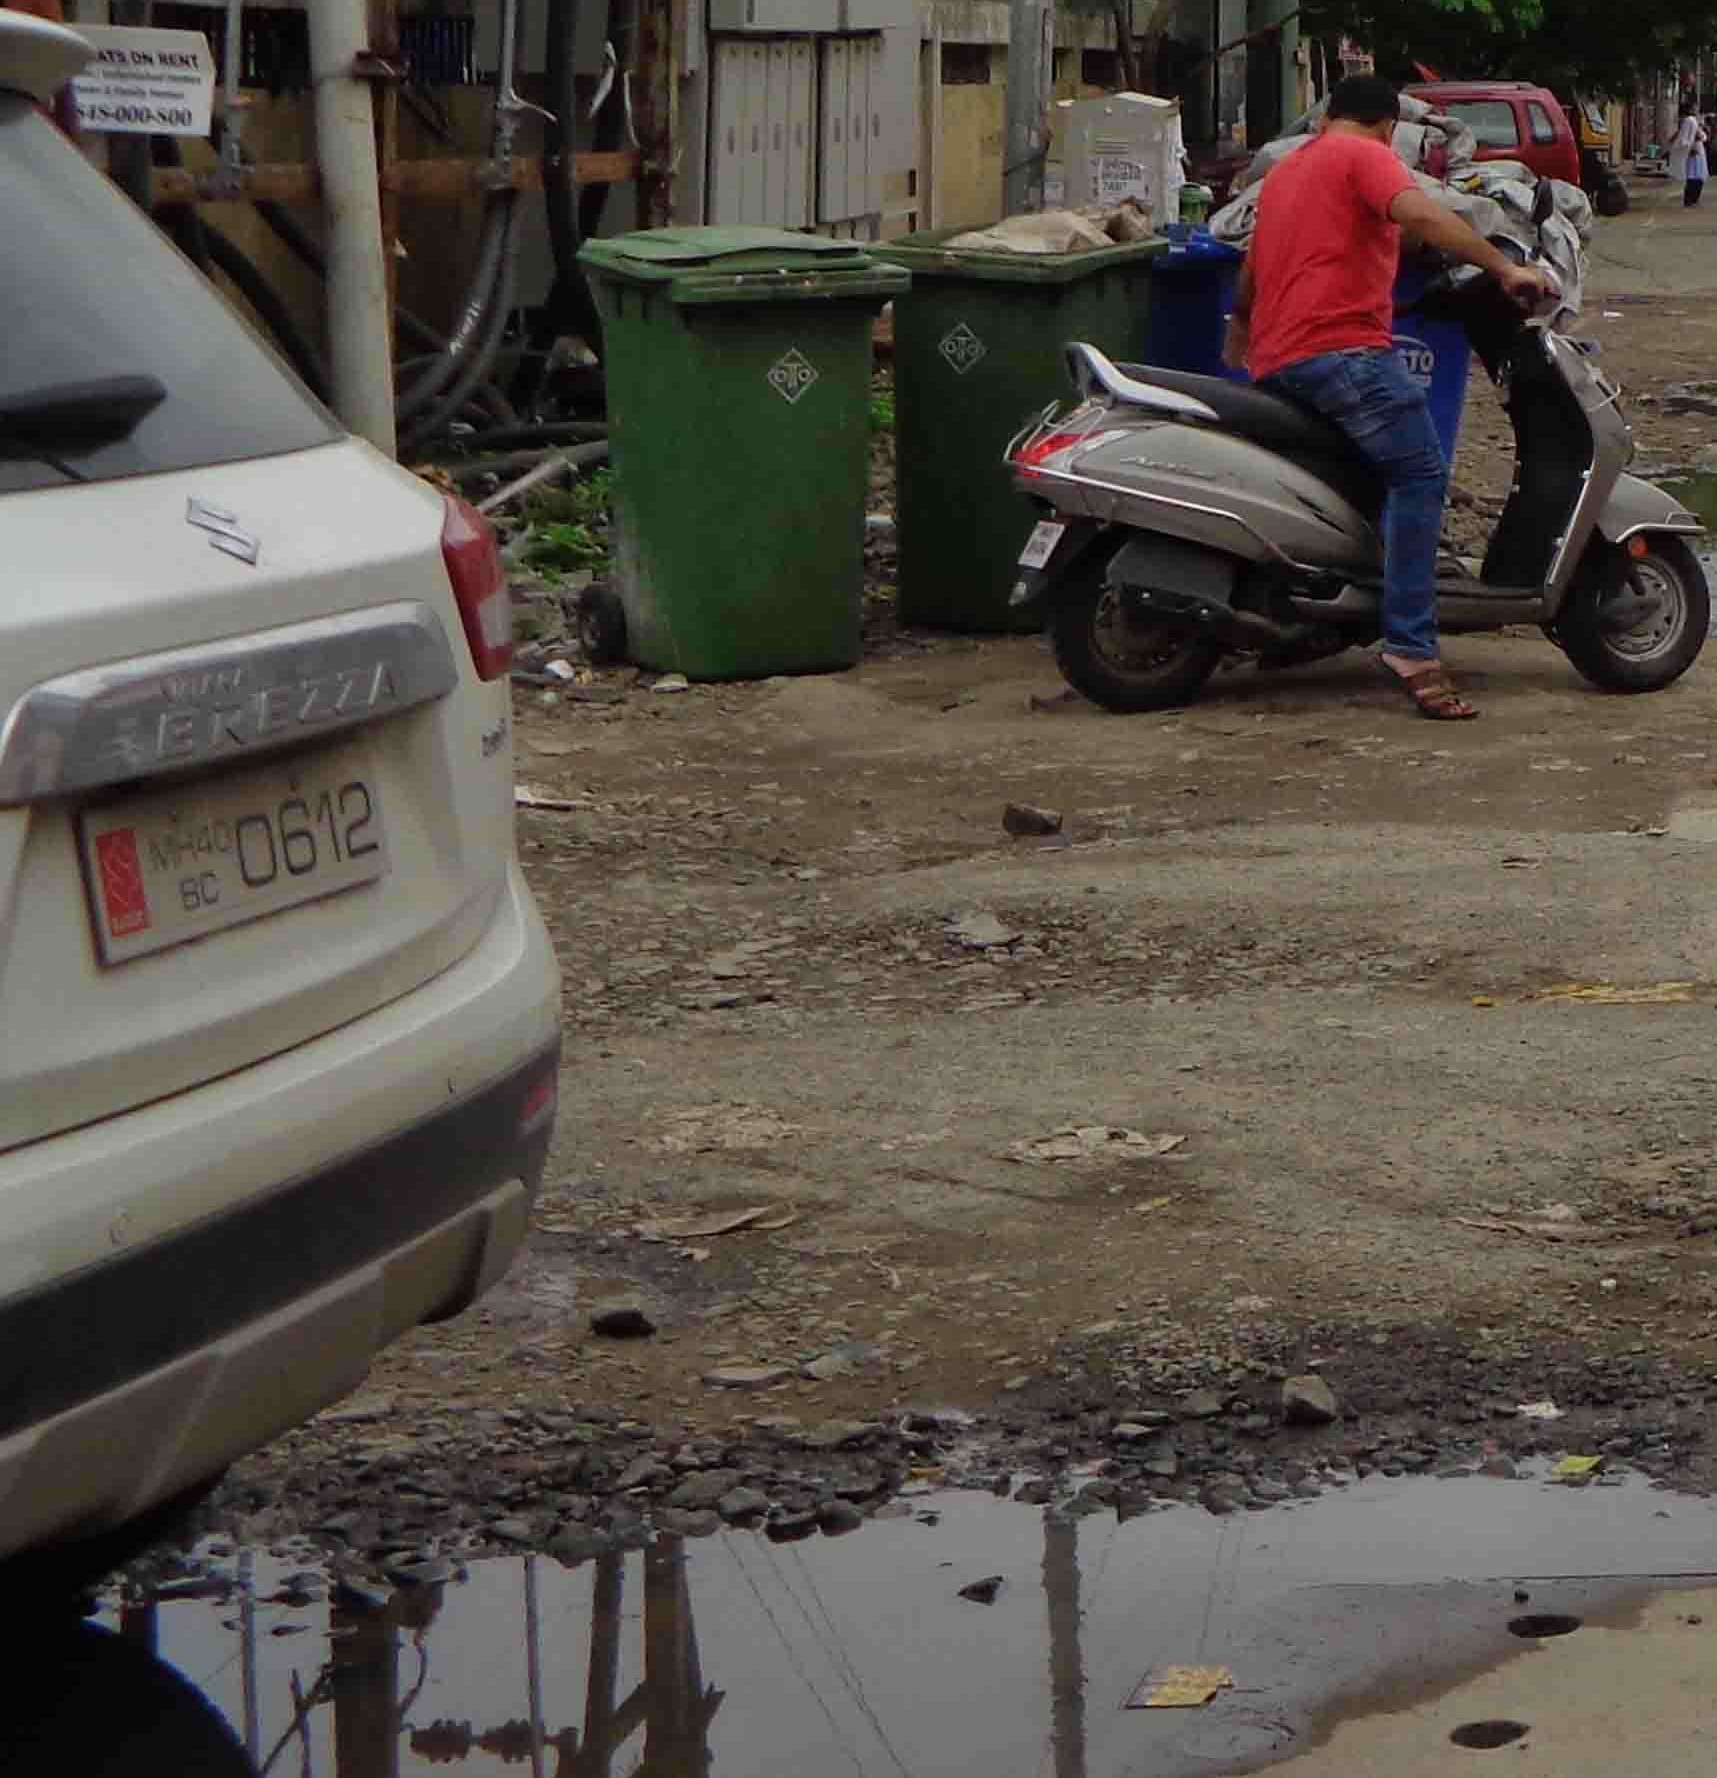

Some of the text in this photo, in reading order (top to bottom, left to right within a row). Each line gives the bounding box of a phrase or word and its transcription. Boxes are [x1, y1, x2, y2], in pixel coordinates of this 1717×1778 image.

[131, 51, 153, 64] ON
[159, 53, 199, 68] RENT
[238, 781, 379, 888] 0612
